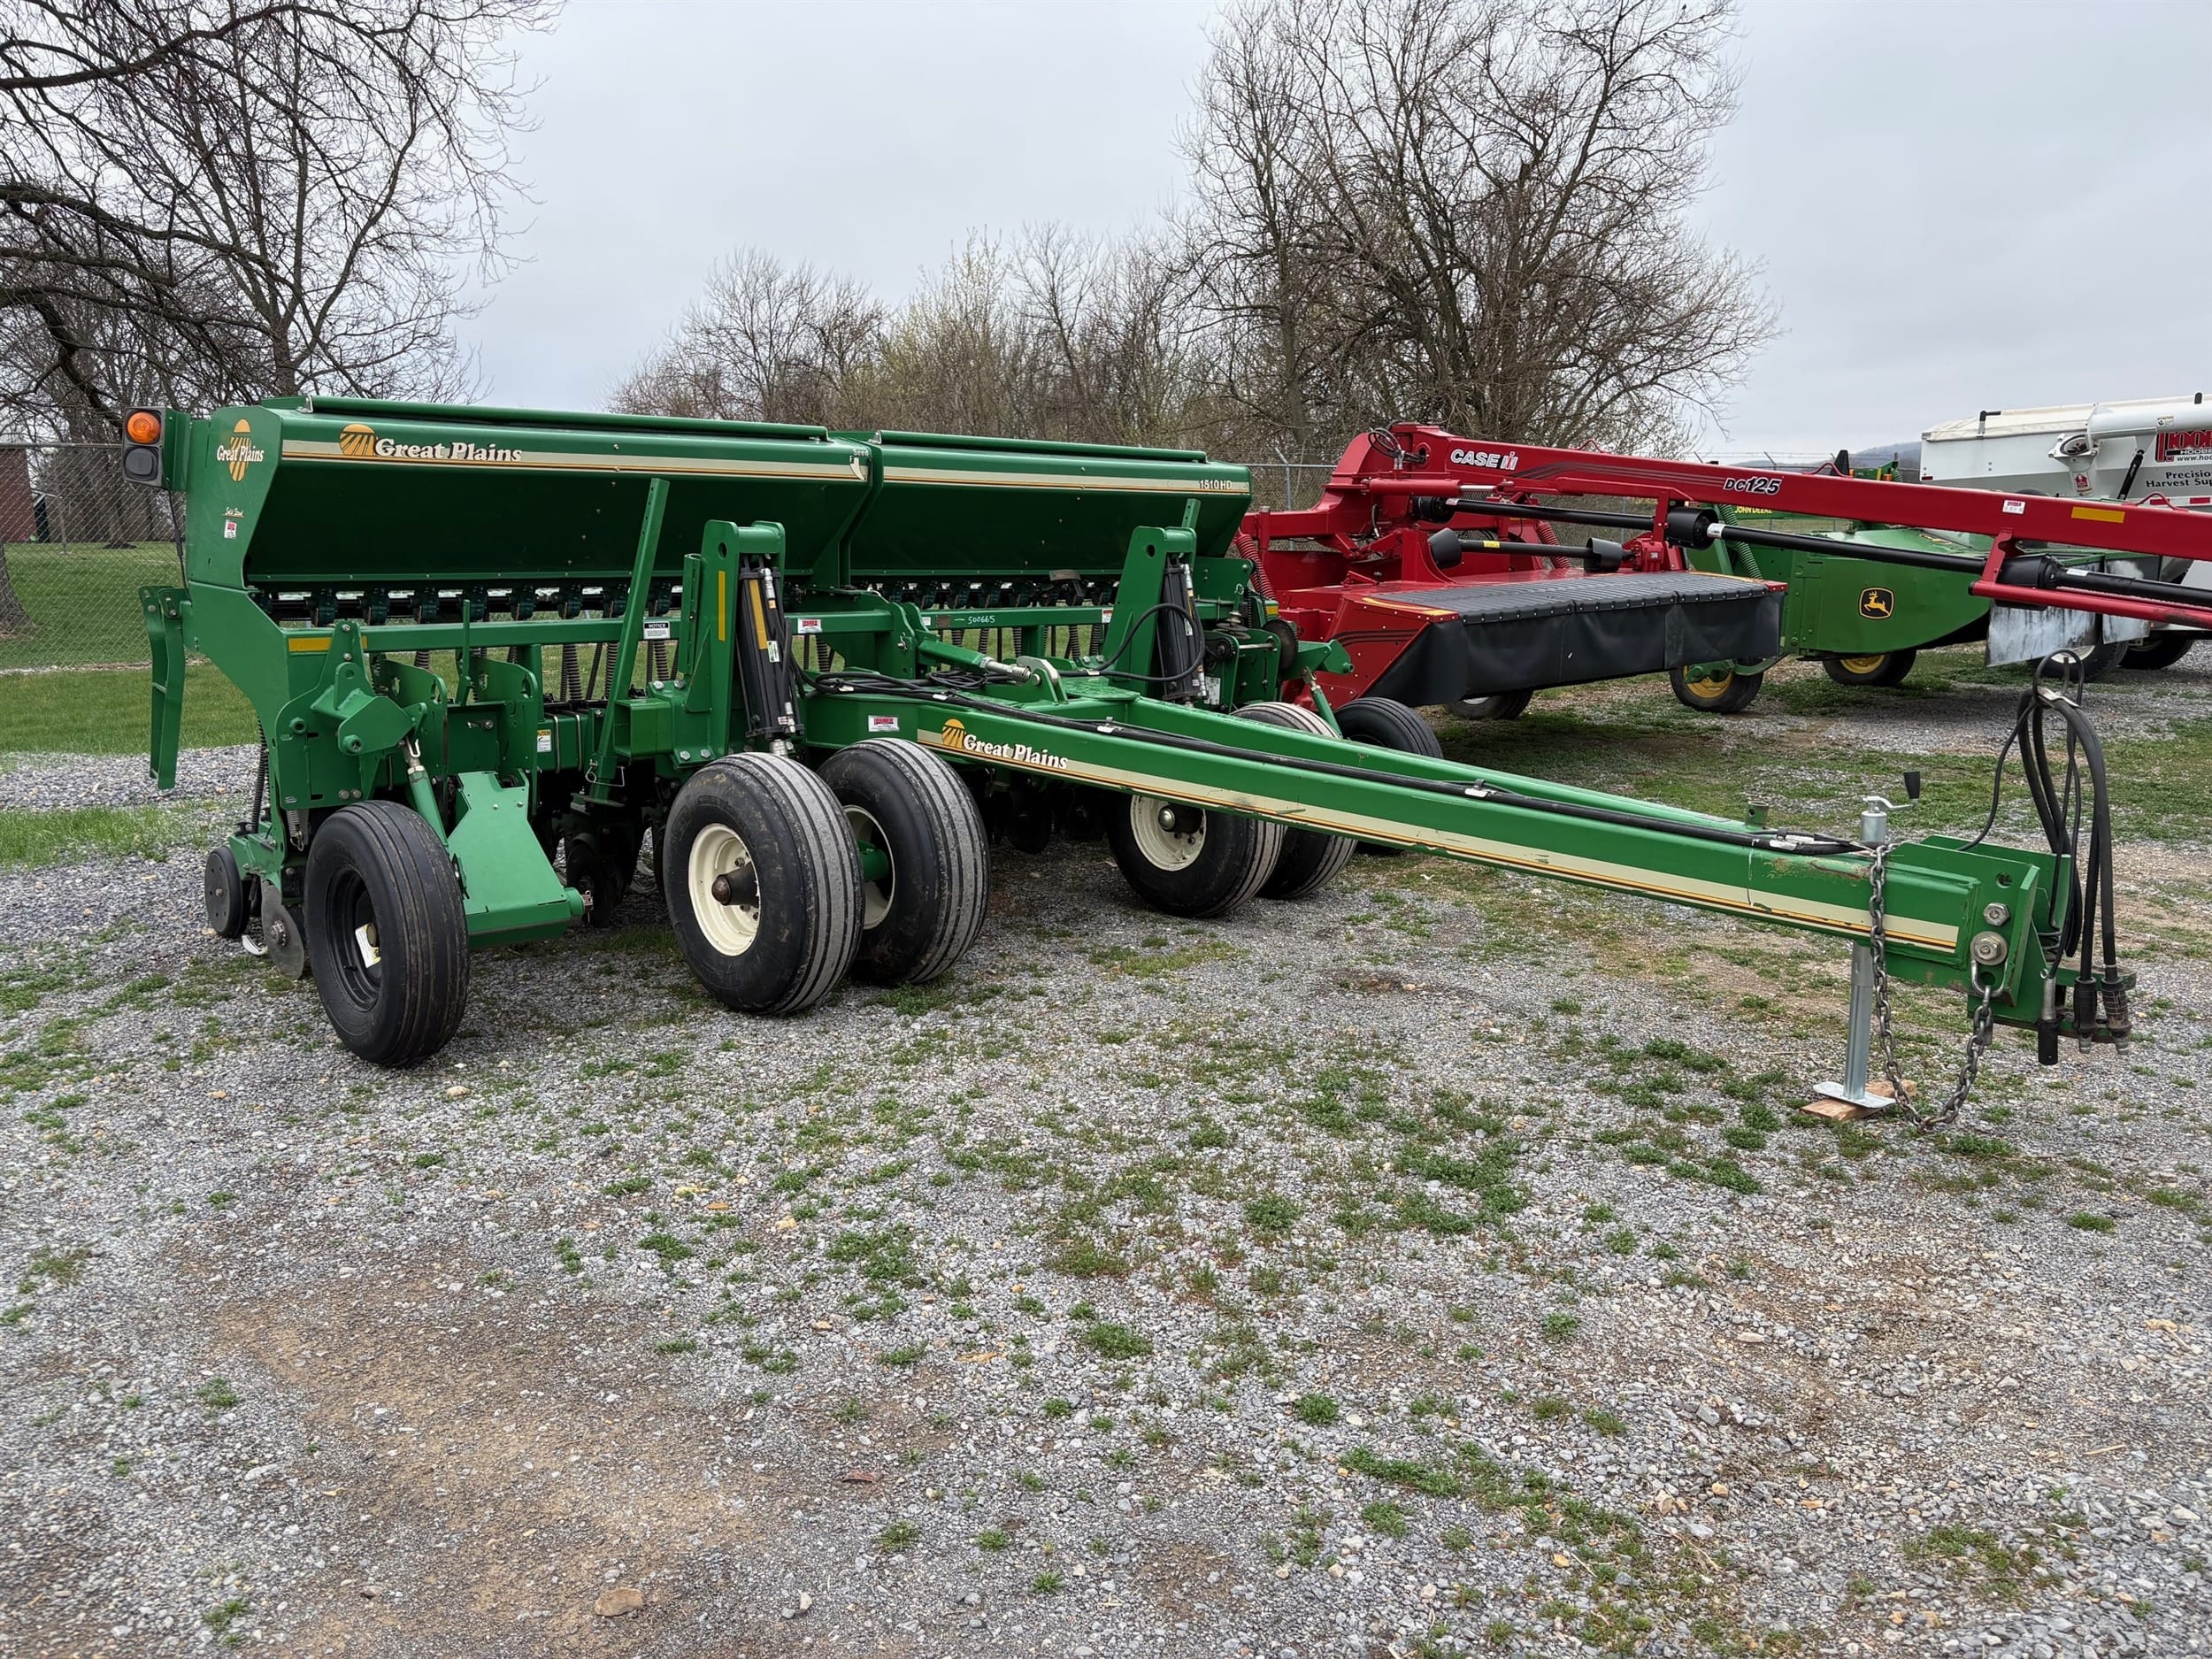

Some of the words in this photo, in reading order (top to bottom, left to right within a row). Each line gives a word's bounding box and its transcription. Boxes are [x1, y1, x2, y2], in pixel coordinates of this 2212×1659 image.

[217, 445, 238, 461] Great
[239, 445, 265, 462] Plains
[375, 438, 445, 458] Great
[449, 442, 522, 462] Plains
[1450, 449, 1500, 468] CASE
[1723, 476, 1782, 495] DC125
[2146, 479, 2189, 488] Harvest
[964, 734, 1012, 758] Great
[1012, 743, 1069, 770] Plains
